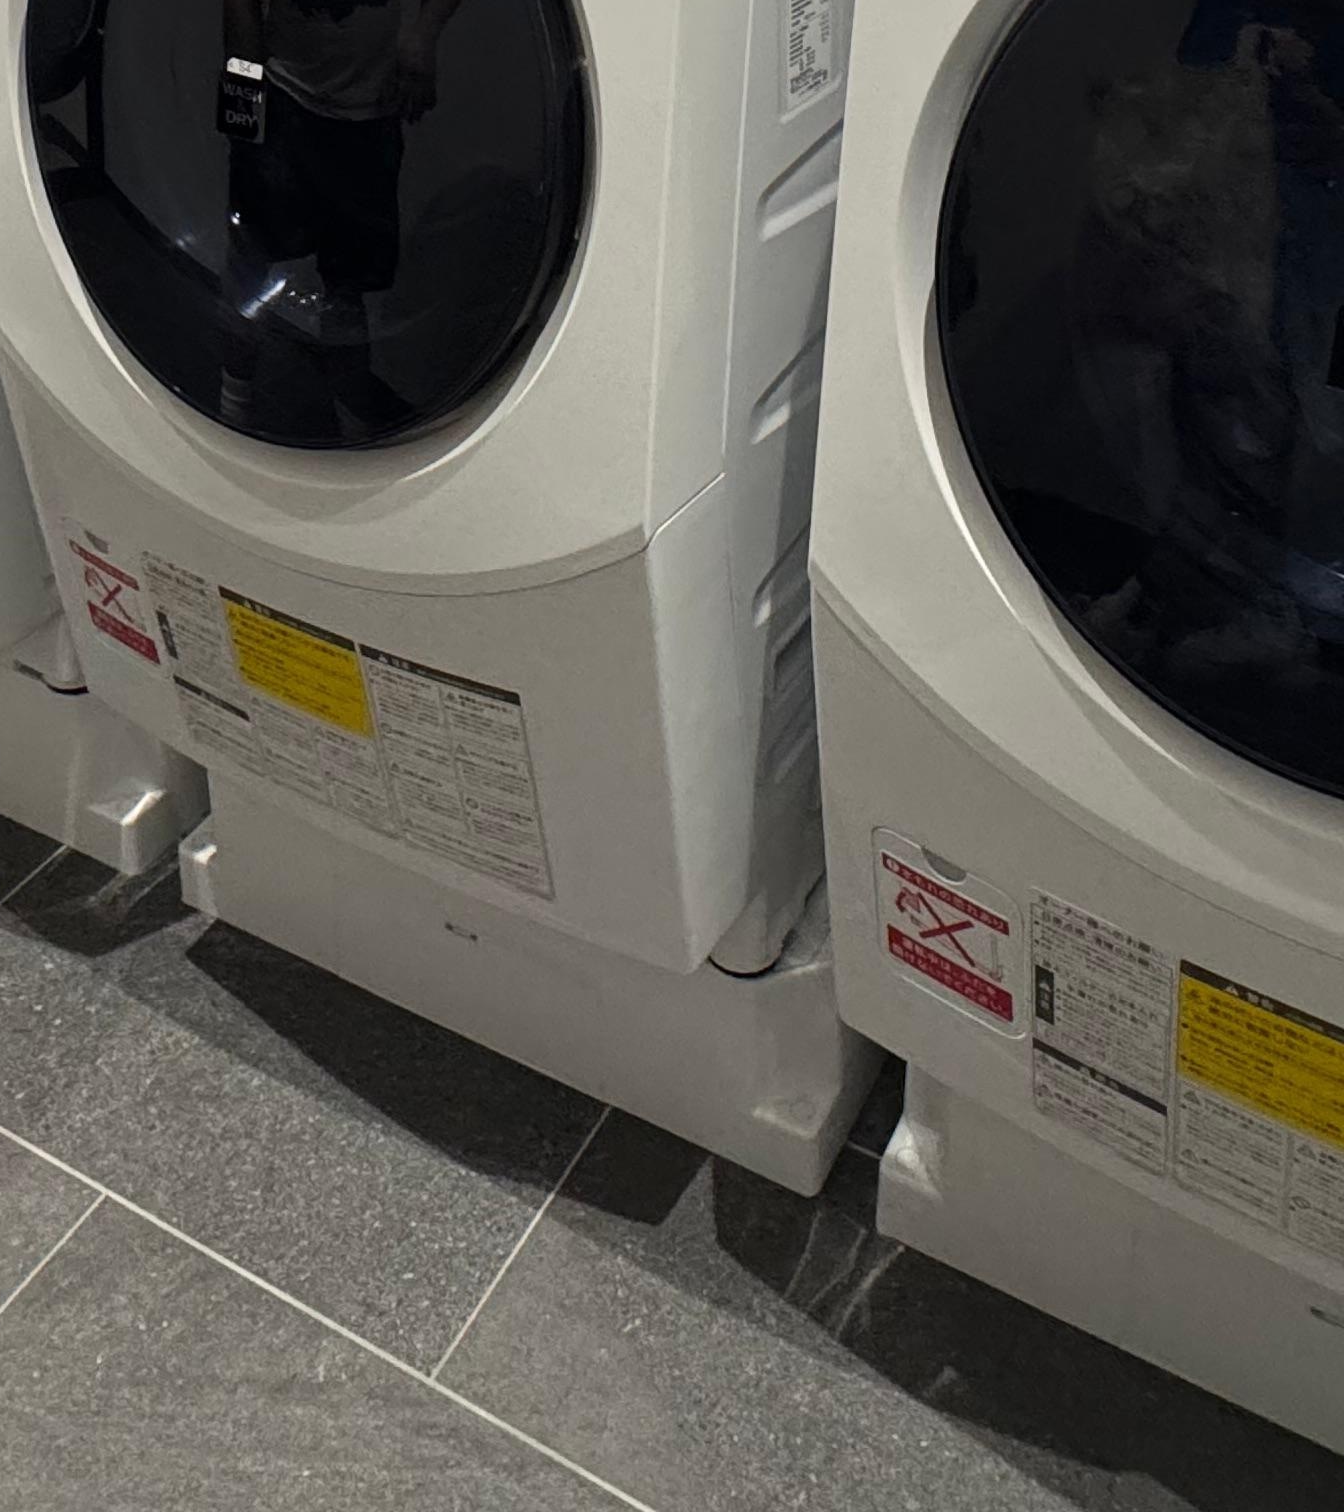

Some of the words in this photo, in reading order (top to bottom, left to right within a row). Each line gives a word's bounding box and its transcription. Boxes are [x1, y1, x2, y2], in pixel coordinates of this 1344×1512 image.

[239, 61, 252, 74] S4
[223, 82, 262, 104] WASH
[226, 110, 258, 127] DRY
